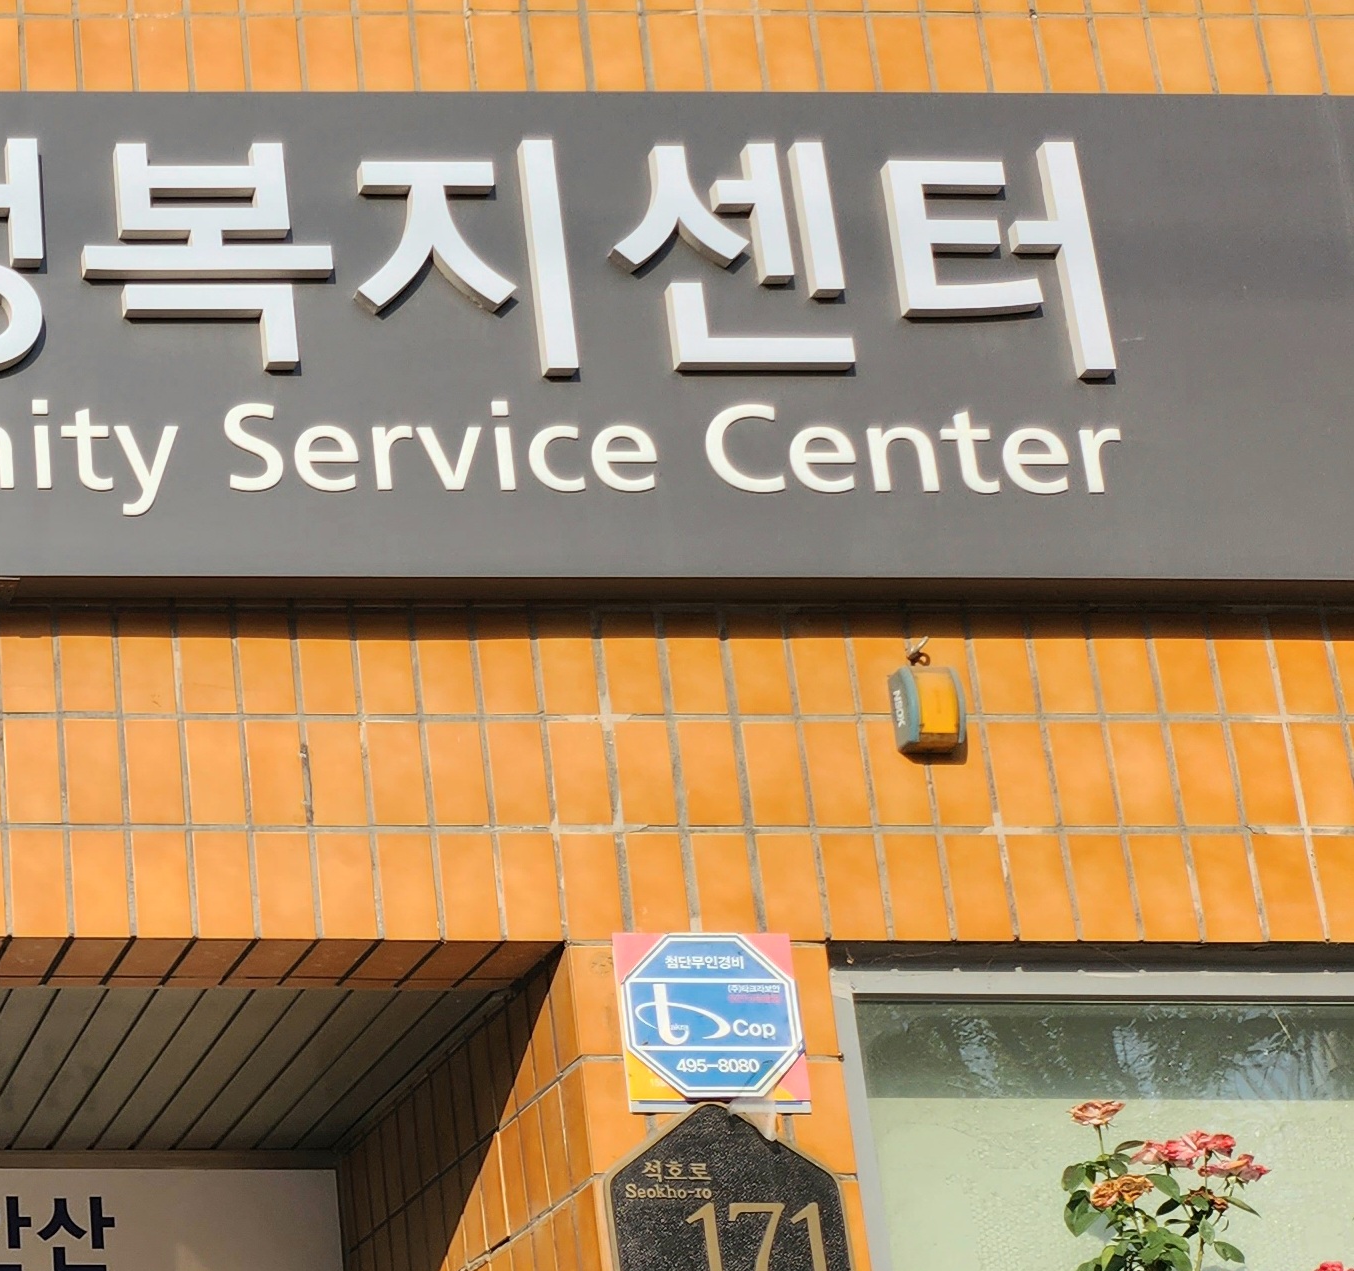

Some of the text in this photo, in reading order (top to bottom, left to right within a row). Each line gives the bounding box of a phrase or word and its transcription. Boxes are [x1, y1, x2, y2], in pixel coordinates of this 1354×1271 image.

[226, 400, 660, 494] Service
[704, 403, 1122, 495] Center
[664, 955, 745, 970] 첨단무인경비
[732, 1018, 776, 1040] Cop
[675, 1058, 760, 1074] 495-8080
[625, 1183, 713, 1200] Seokho-ro
